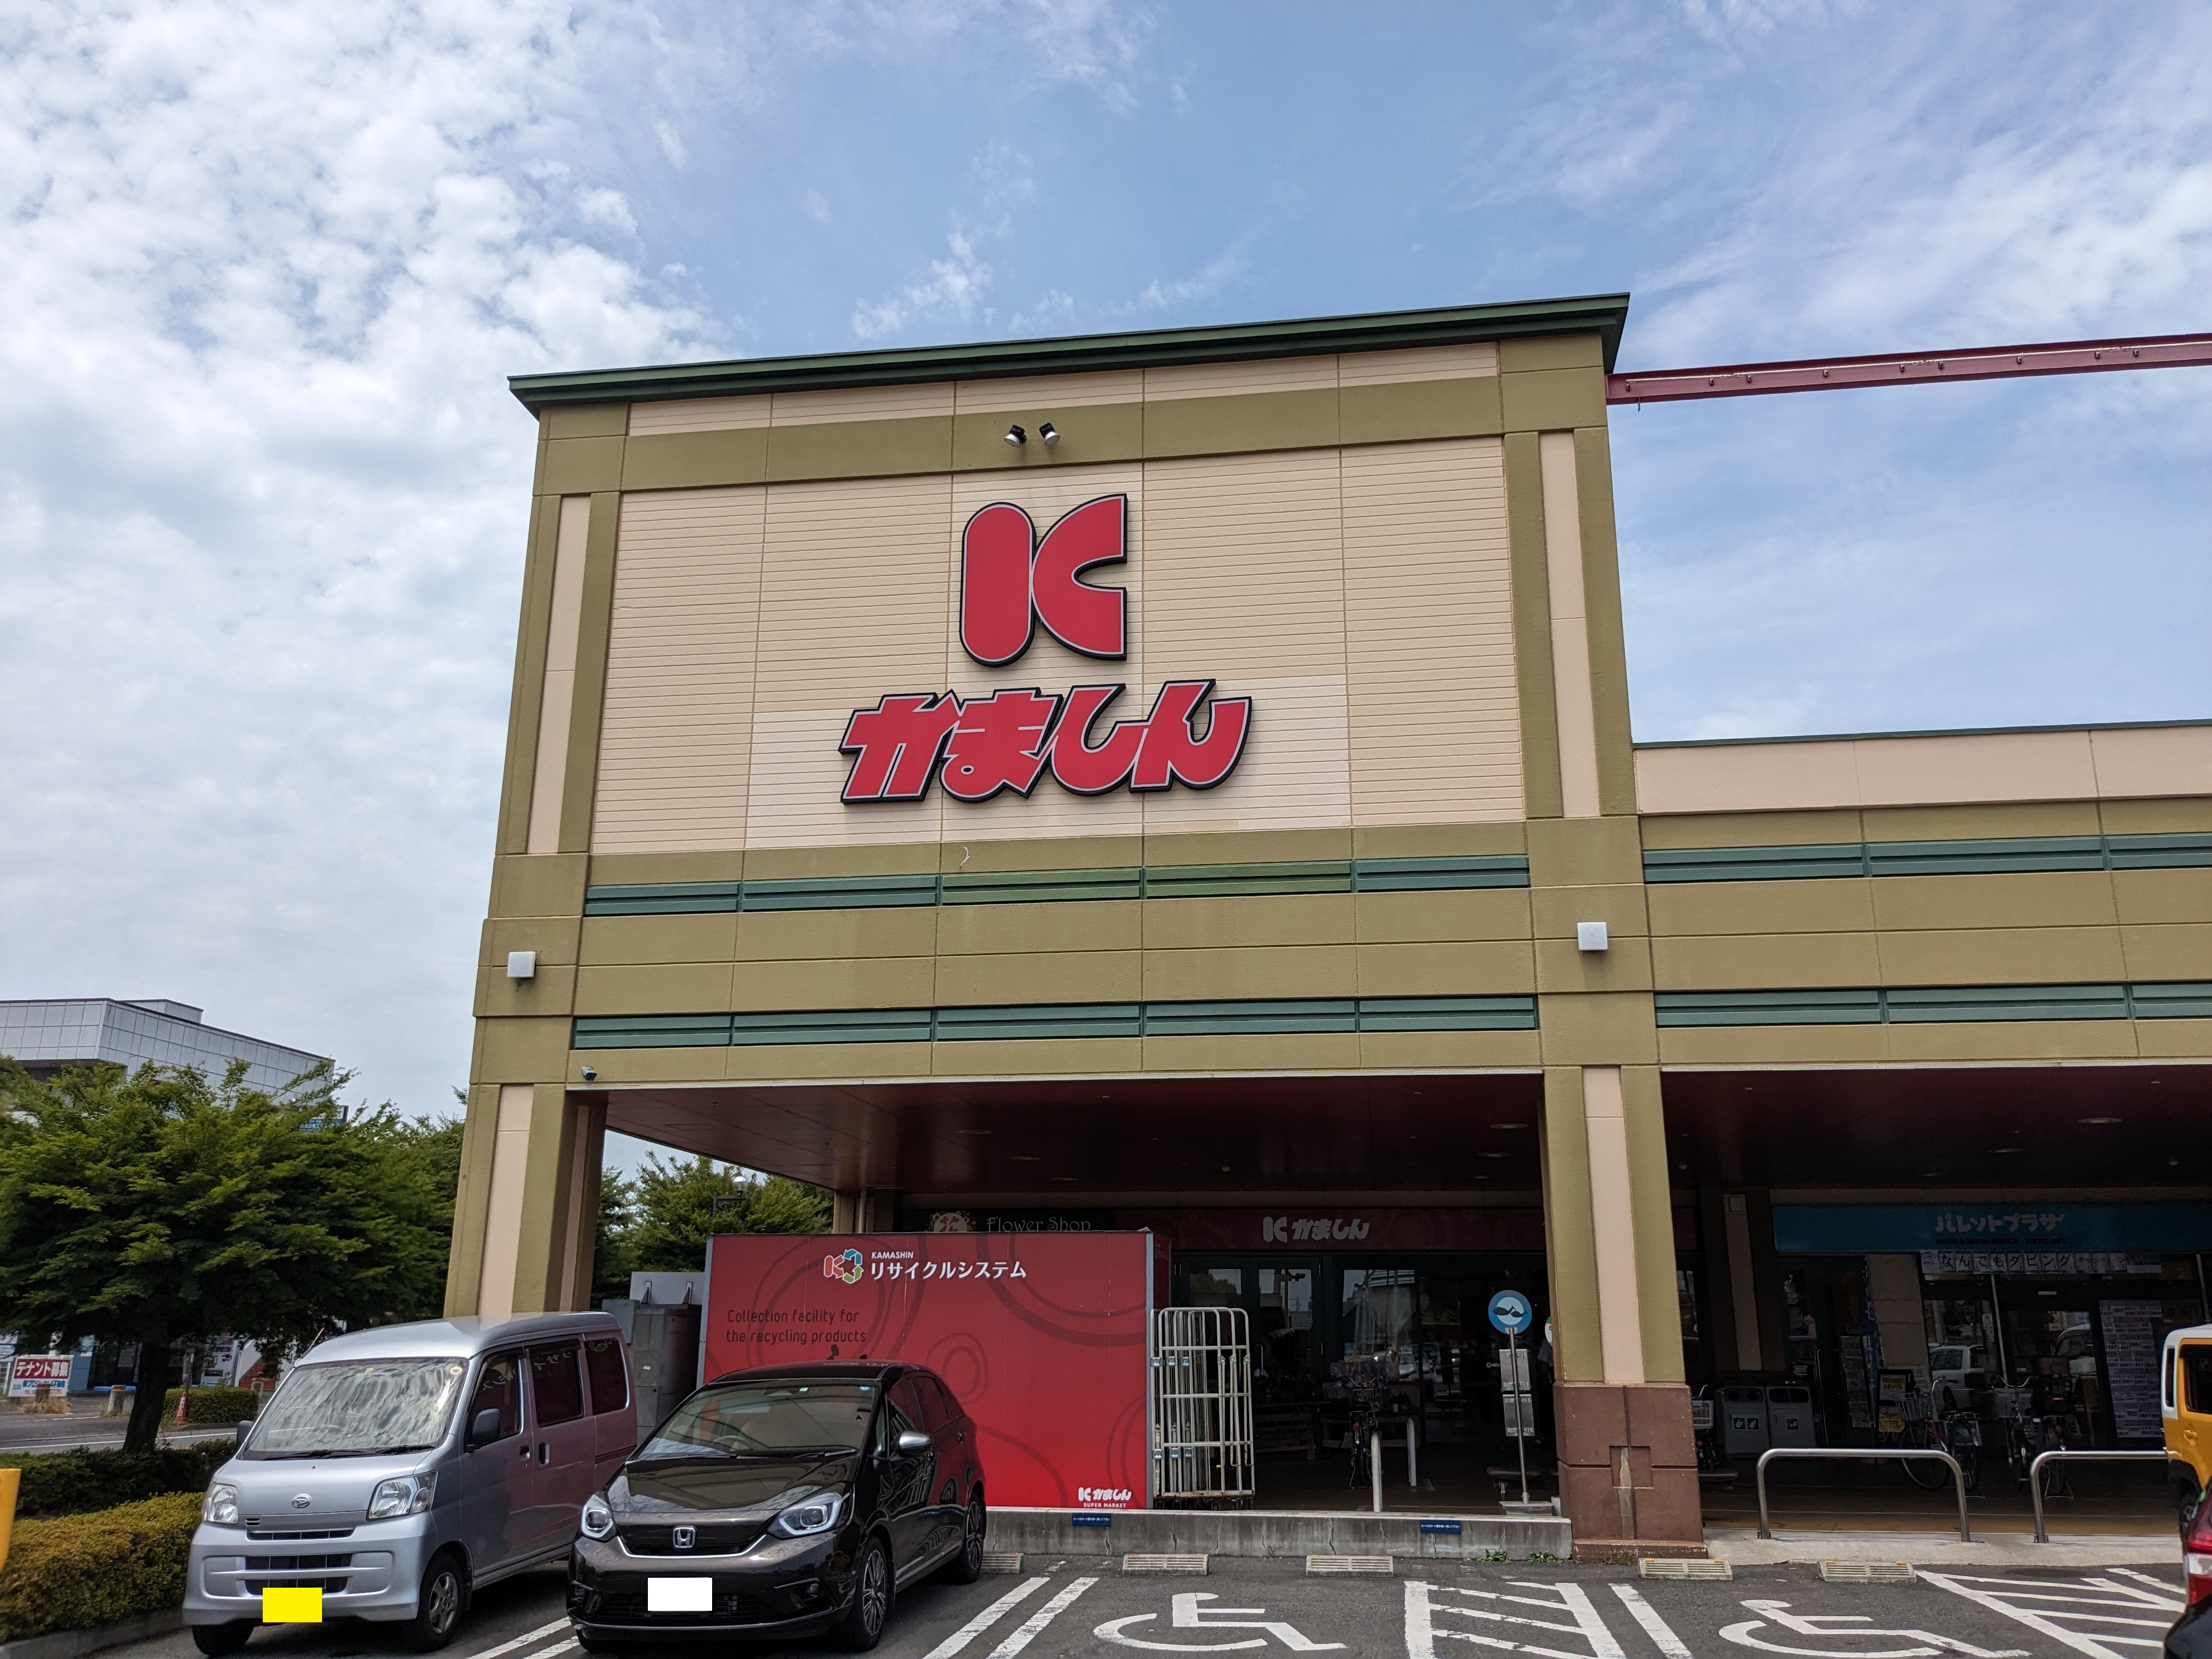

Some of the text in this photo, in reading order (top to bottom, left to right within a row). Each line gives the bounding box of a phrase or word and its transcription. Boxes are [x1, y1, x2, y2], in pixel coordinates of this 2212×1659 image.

[838, 679, 1251, 804] かましん
[986, 1216, 1043, 1232] Flower
[1291, 1218, 1369, 1240] かましん
[1935, 1213, 2064, 1232] パレットプラザ
[871, 1261, 1027, 1280] リサイクルシステム
[728, 1309, 859, 1325] Collection facility for
[727, 1329, 866, 1345] the recycling products
[16, 1361, 69, 1377] テナント募集
[1092, 1488, 1132, 1500] かましん
